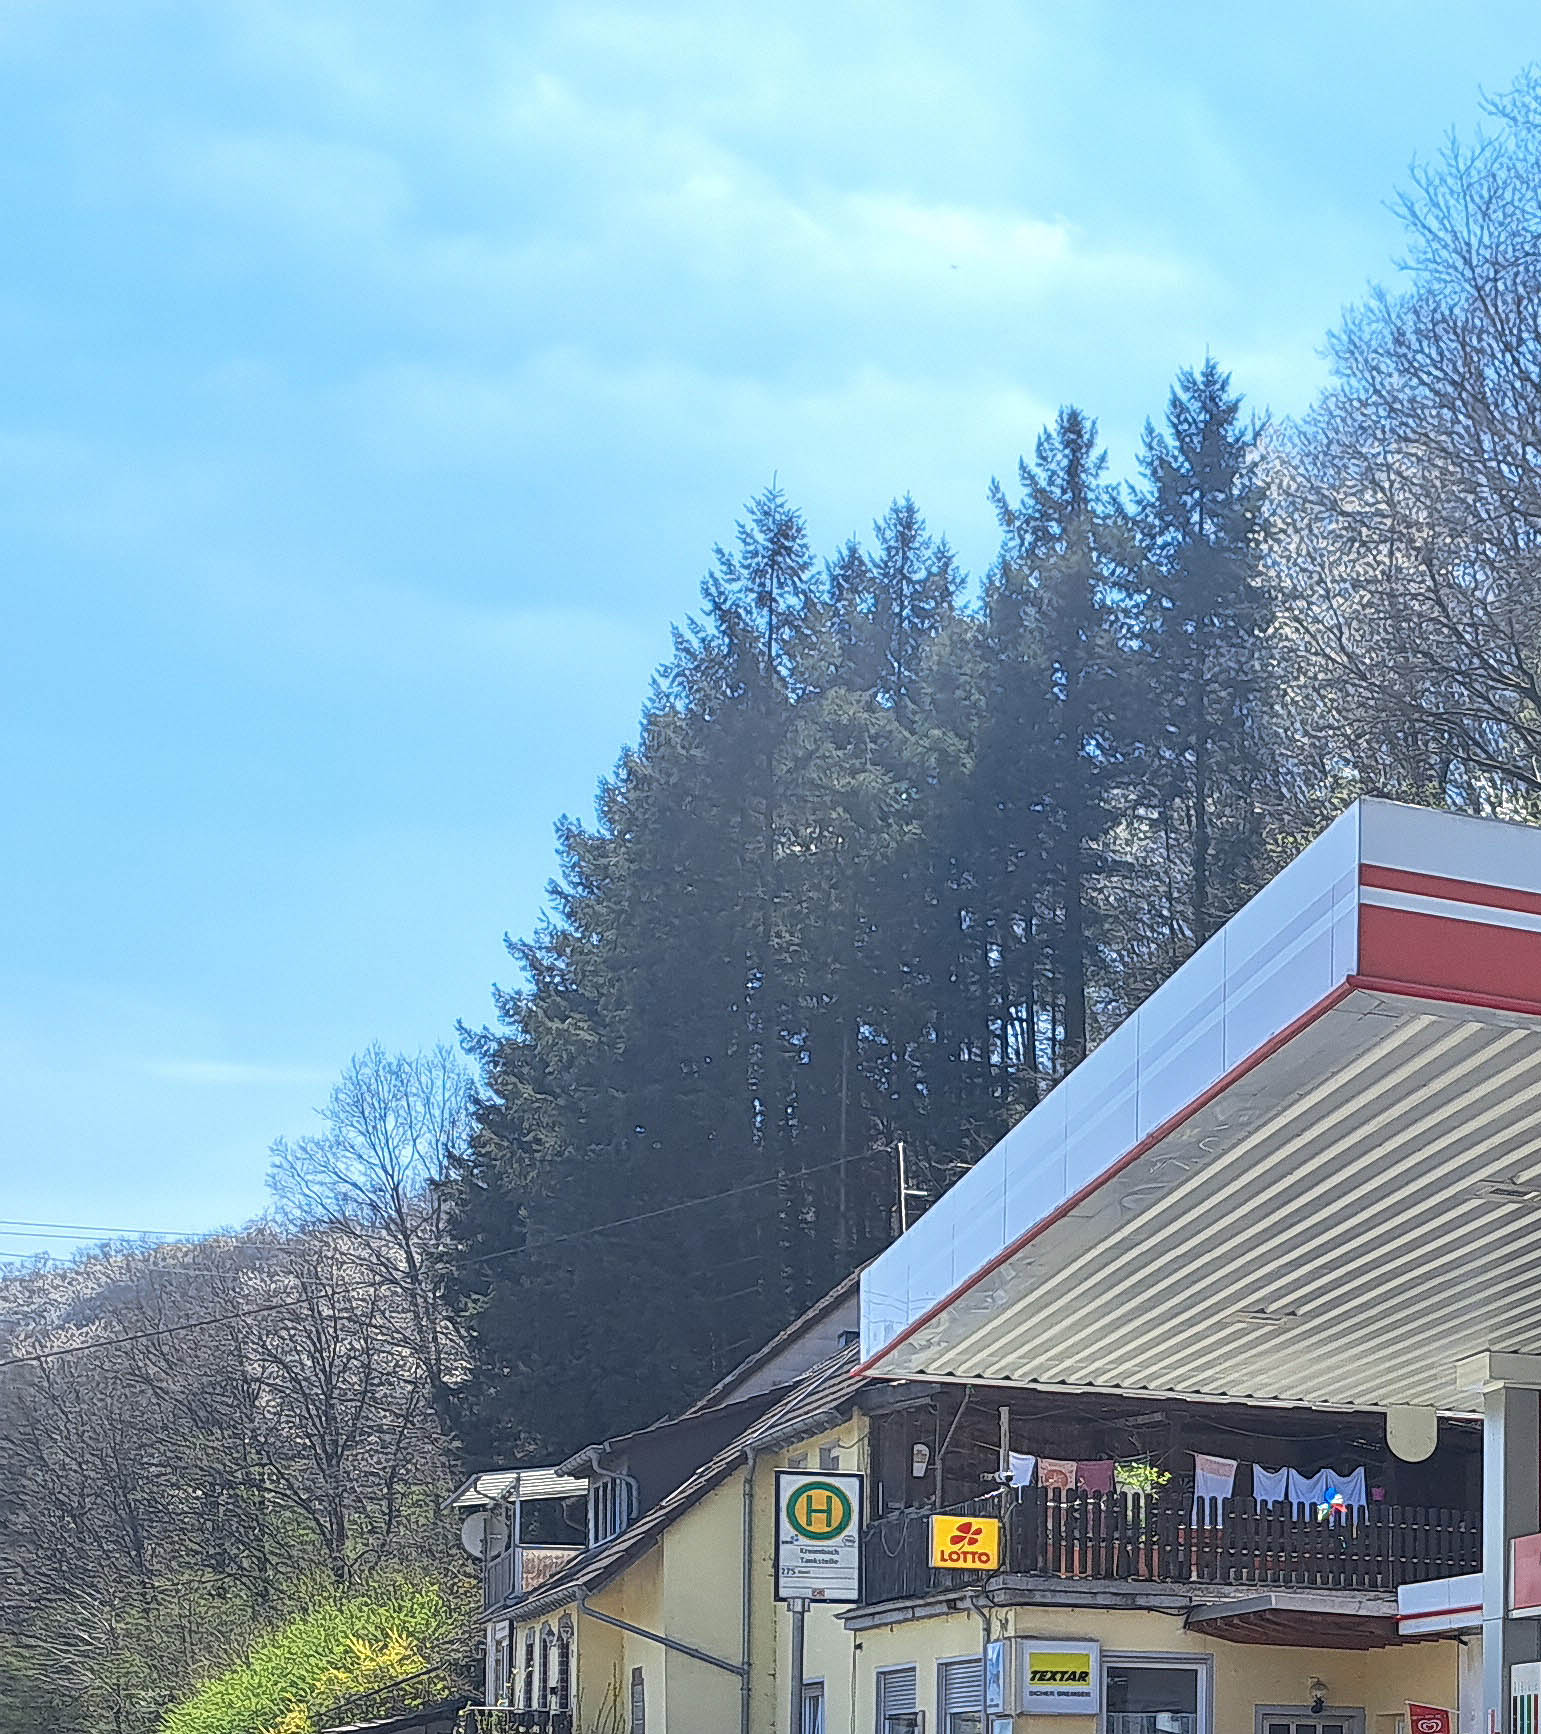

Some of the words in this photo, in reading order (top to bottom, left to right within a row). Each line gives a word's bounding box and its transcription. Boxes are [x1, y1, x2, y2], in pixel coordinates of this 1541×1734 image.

[806, 1494, 833, 1528] H
[940, 1549, 991, 1565] LOTTO
[1029, 1670, 1090, 1682] TEXTAR
